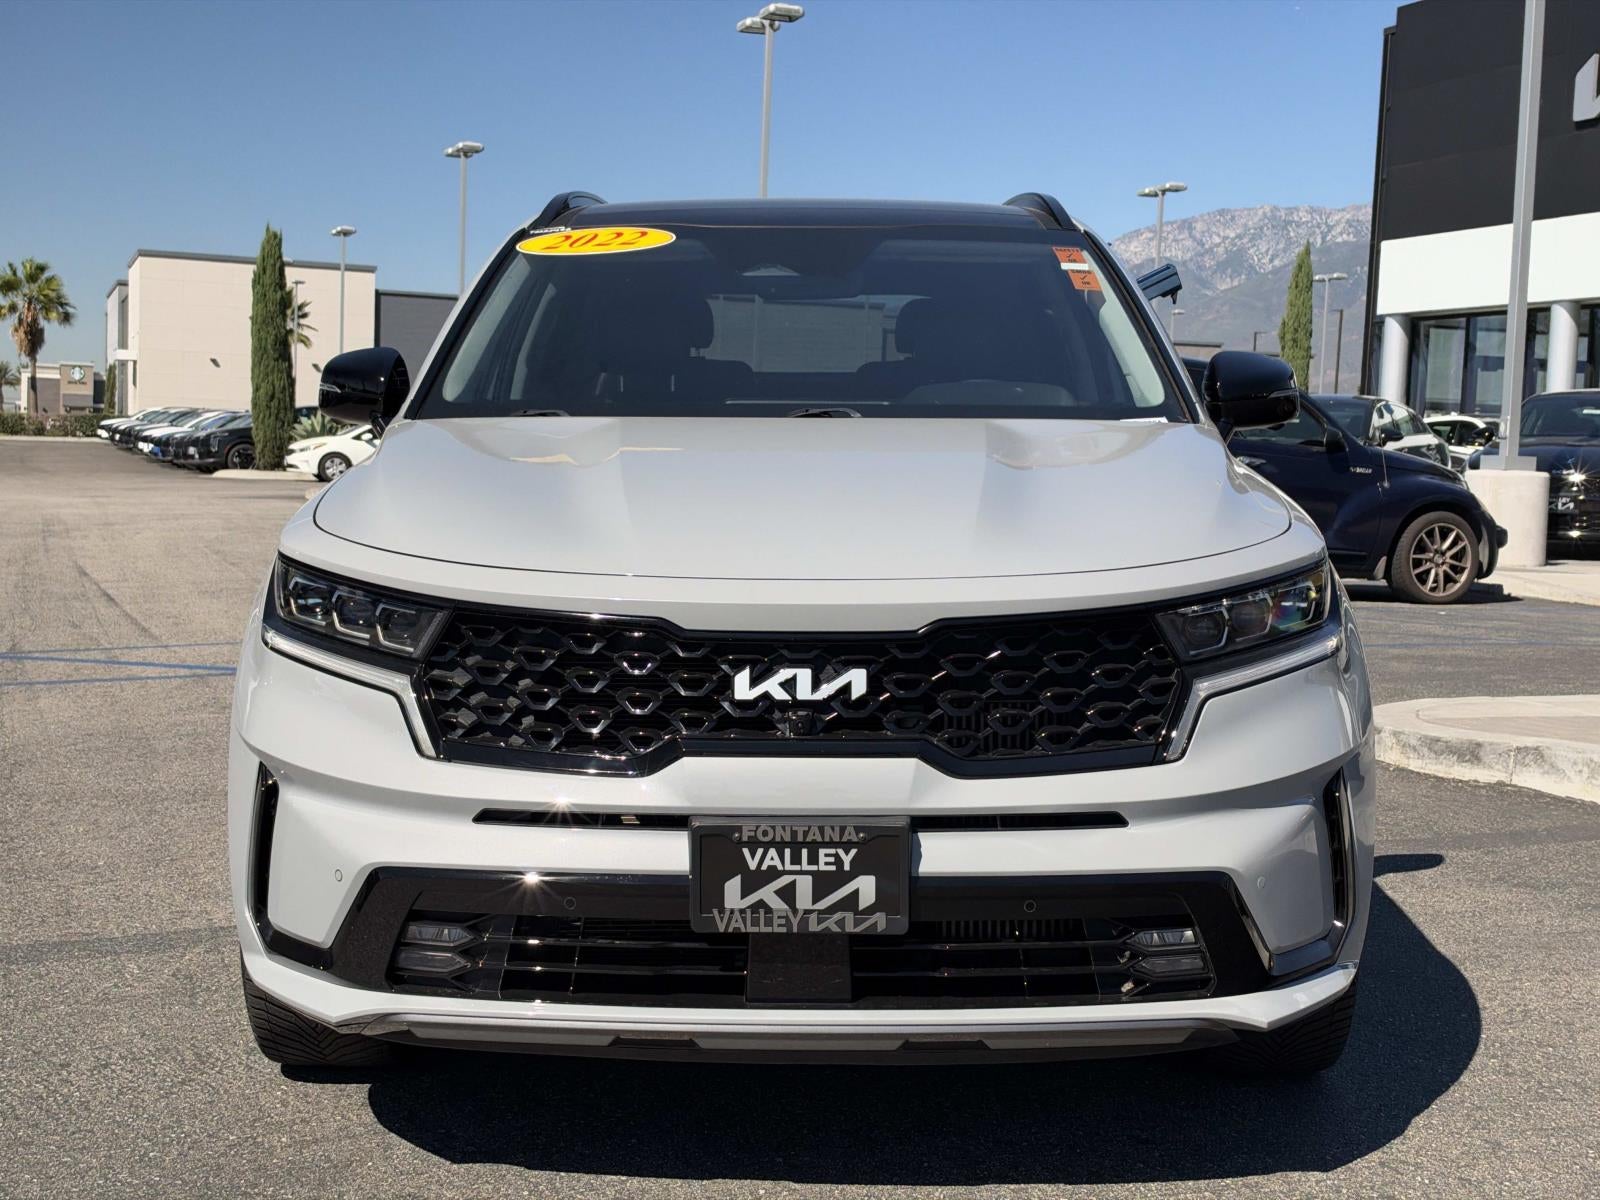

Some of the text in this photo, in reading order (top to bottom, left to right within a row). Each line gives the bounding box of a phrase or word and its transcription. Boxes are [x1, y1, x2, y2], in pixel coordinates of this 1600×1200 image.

[542, 231, 648, 250] 2022
[734, 666, 867, 700] KIA
[742, 825, 858, 842] FONTANA
[742, 848, 858, 871] VALLEY
[724, 874, 876, 911] KIA
[712, 909, 887, 933] VALLEY KIA
